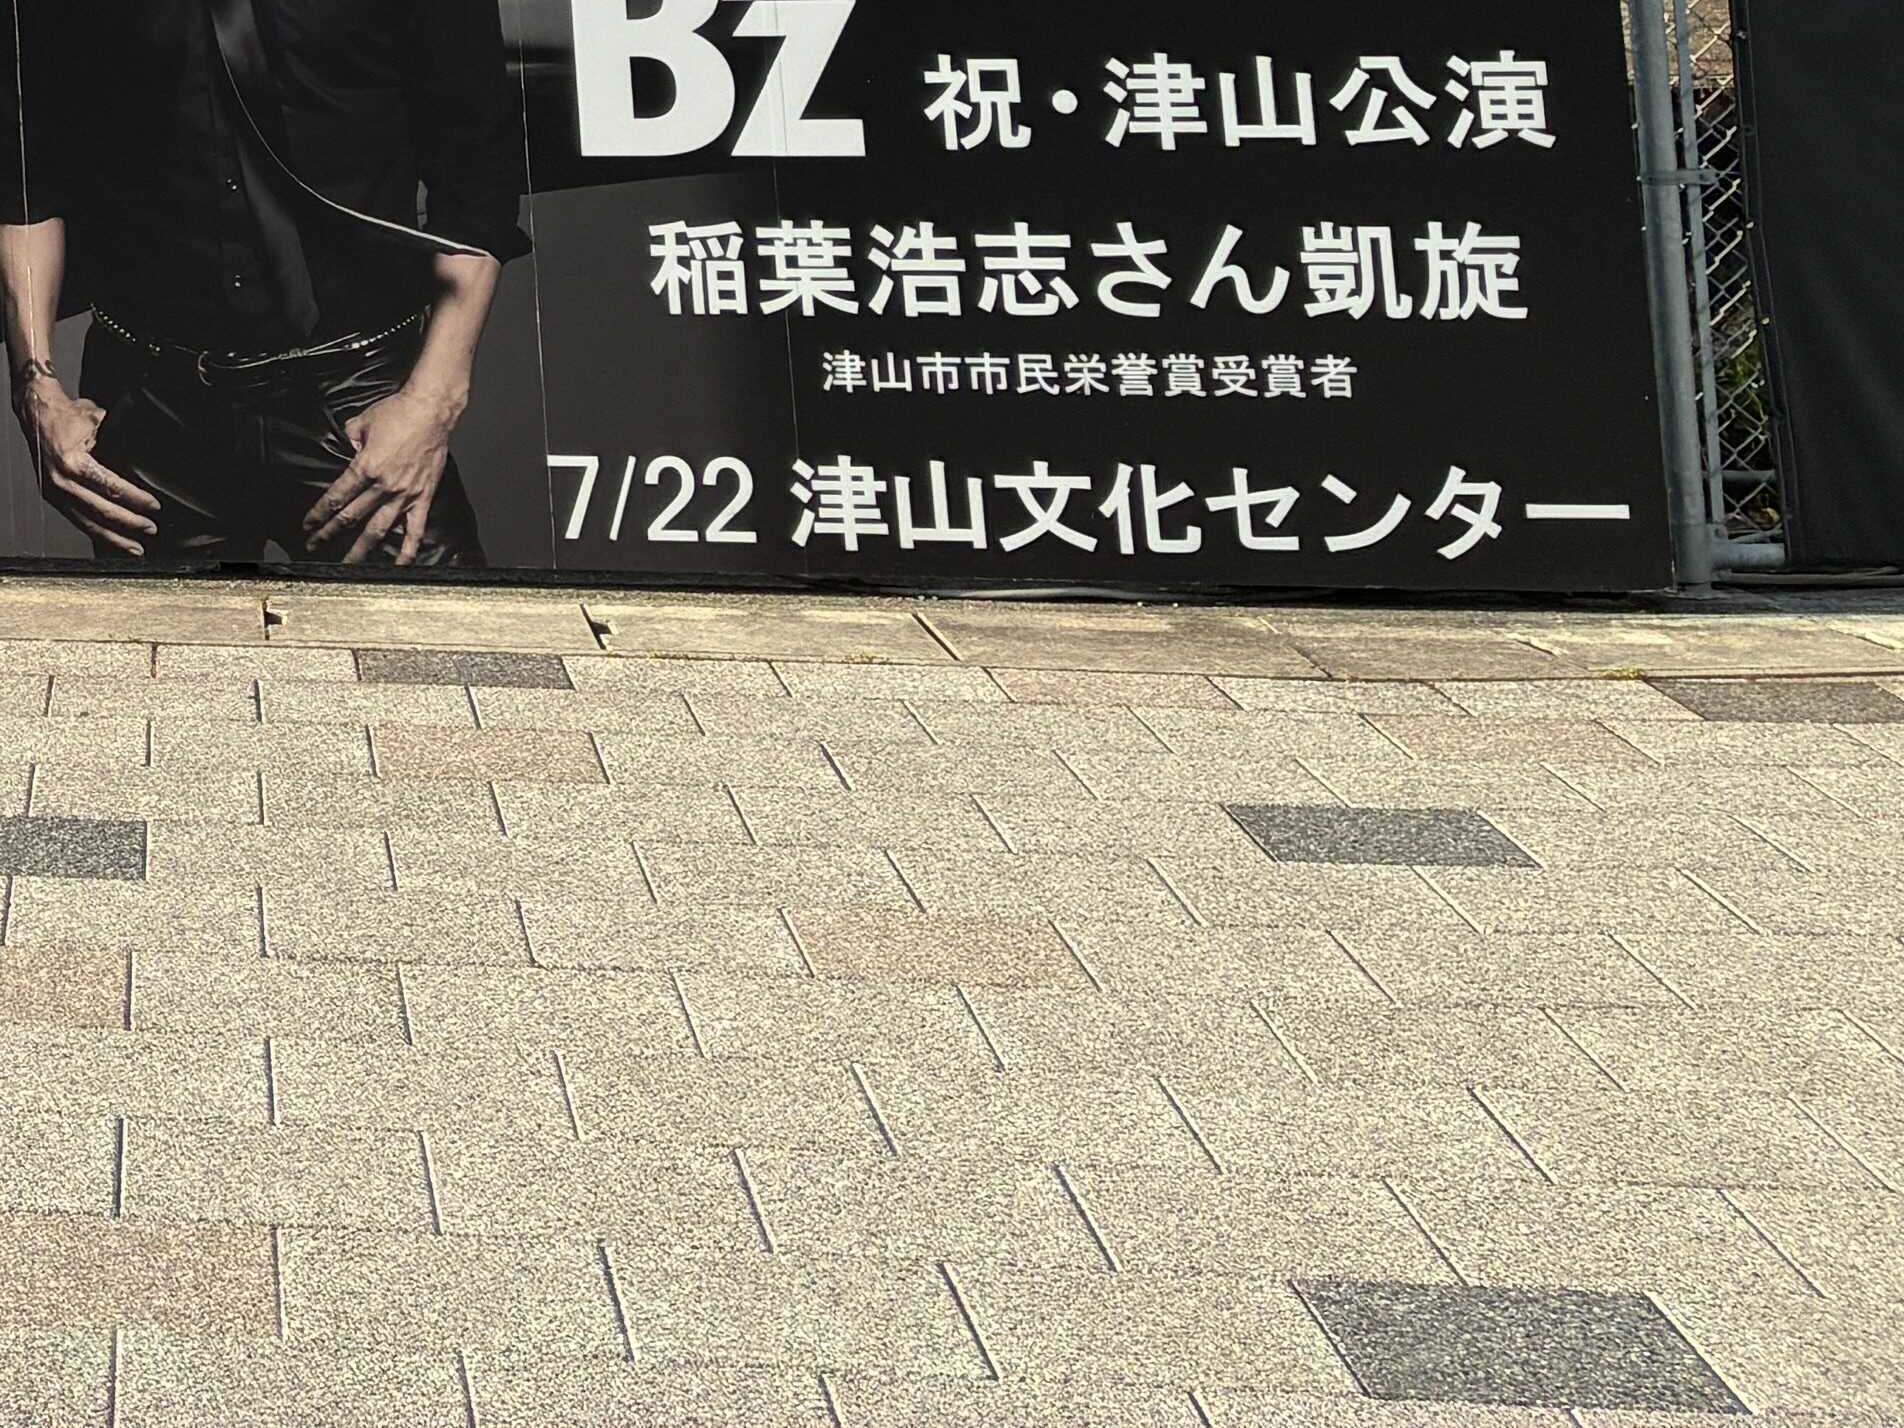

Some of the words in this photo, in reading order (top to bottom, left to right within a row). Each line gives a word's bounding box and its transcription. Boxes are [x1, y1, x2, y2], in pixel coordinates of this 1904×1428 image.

[923, 49, 1557, 151] 祝・津山公演
[648, 219, 1529, 321] 稲葉浩志さん凱旋
[822, 349, 1358, 399] 津山市市民栄誉賞受賞者
[546, 454, 757, 544] 7/22
[789, 454, 1631, 560] 津山文化センター
